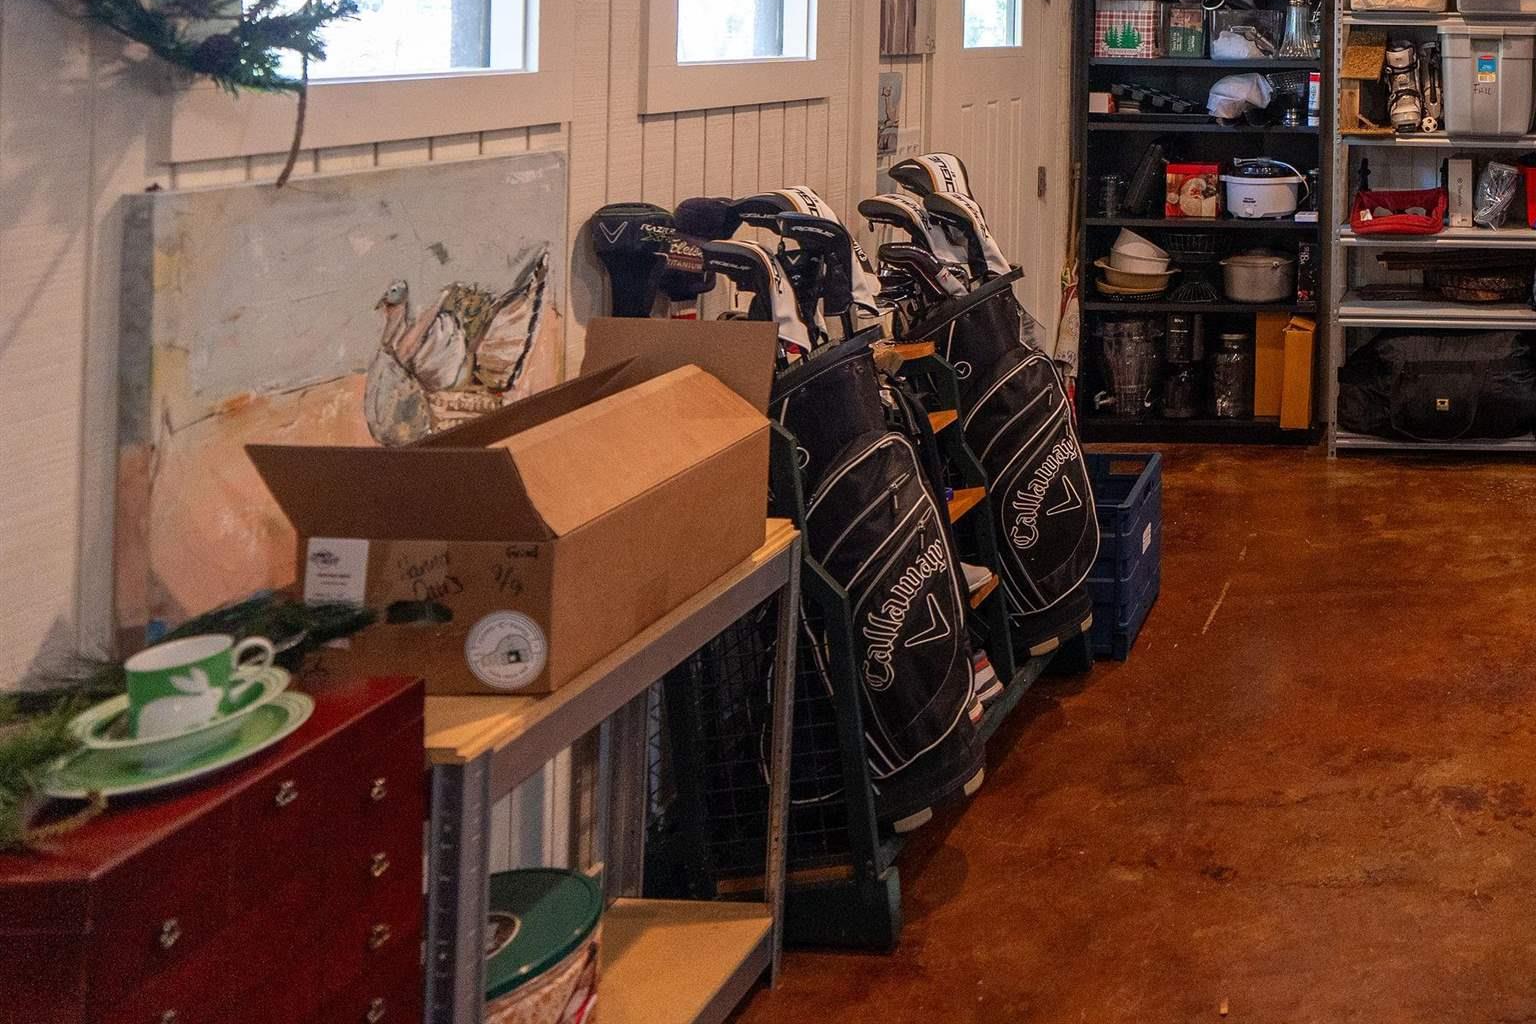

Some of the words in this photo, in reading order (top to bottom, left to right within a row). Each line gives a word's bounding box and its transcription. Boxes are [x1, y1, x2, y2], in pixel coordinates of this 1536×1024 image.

[928, 155, 957, 192] OGUE
[1010, 435, 1078, 549] Callaway
[863, 539, 948, 691] Callaway
